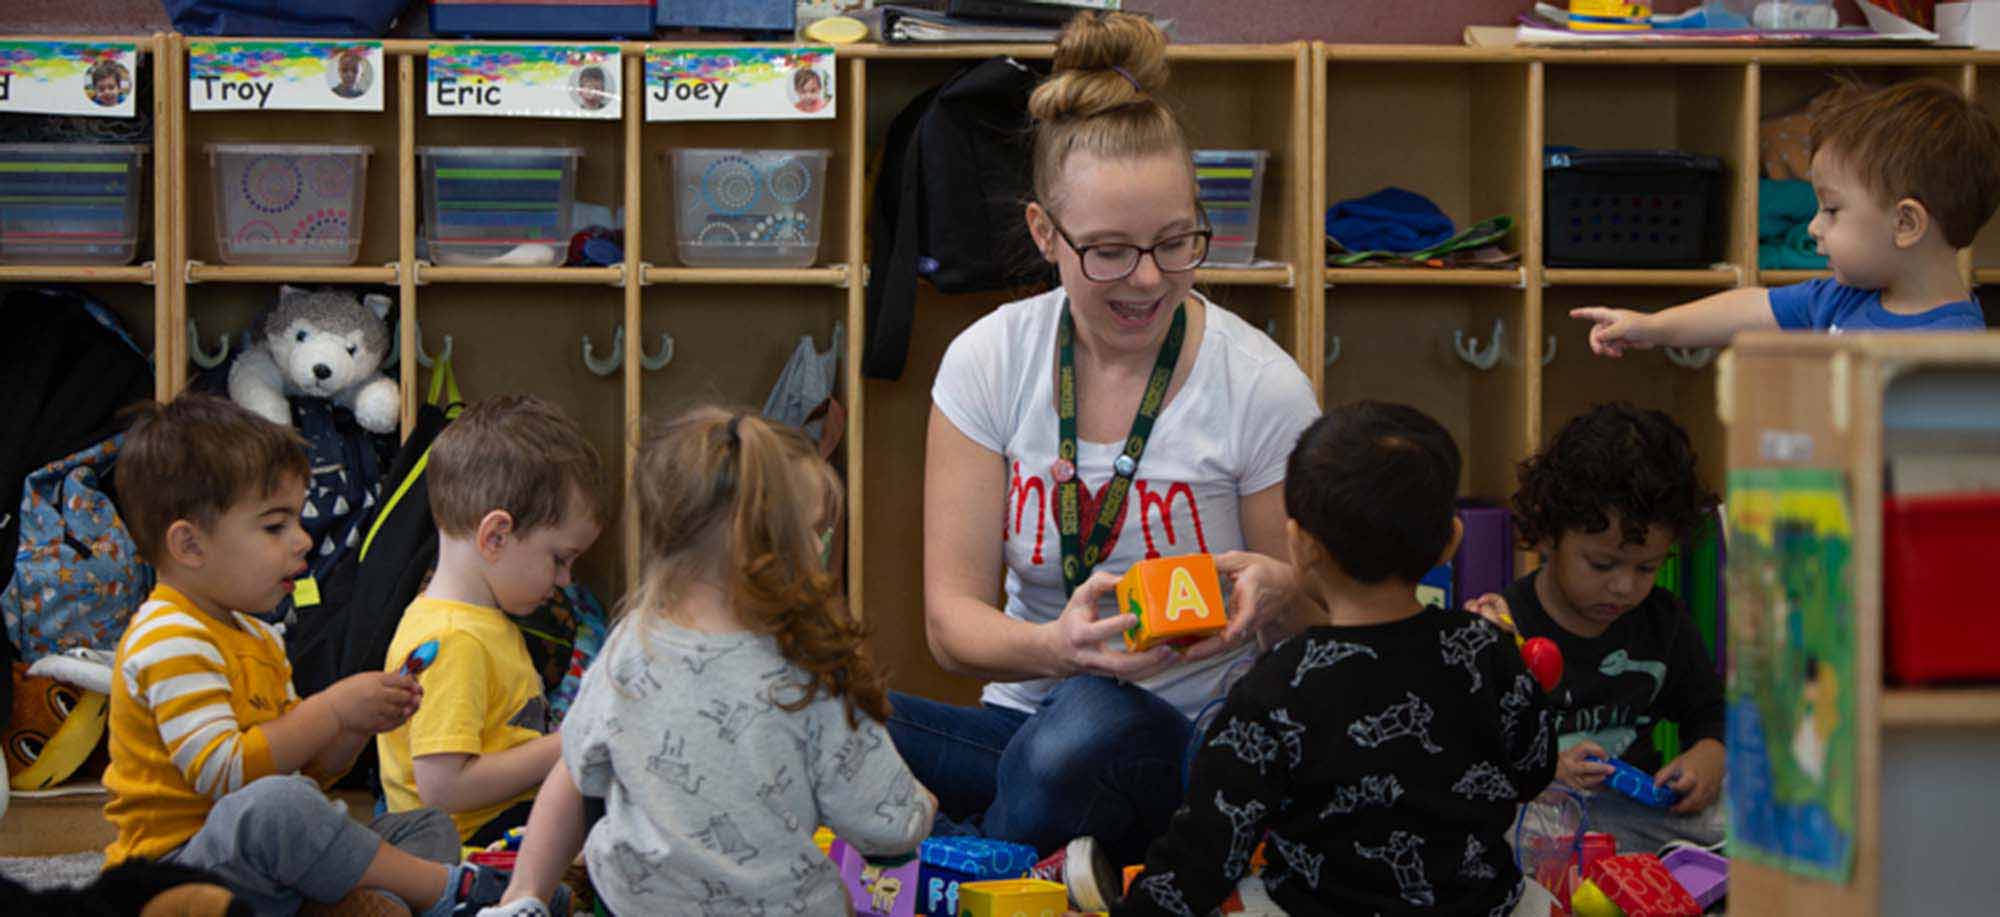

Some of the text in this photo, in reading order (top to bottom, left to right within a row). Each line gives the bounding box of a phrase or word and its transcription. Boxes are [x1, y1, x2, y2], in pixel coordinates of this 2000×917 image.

[197, 75, 273, 108] Troy
[437, 76, 501, 106] Eric
[653, 75, 729, 108] Joey
[1165, 566, 1210, 622] A
